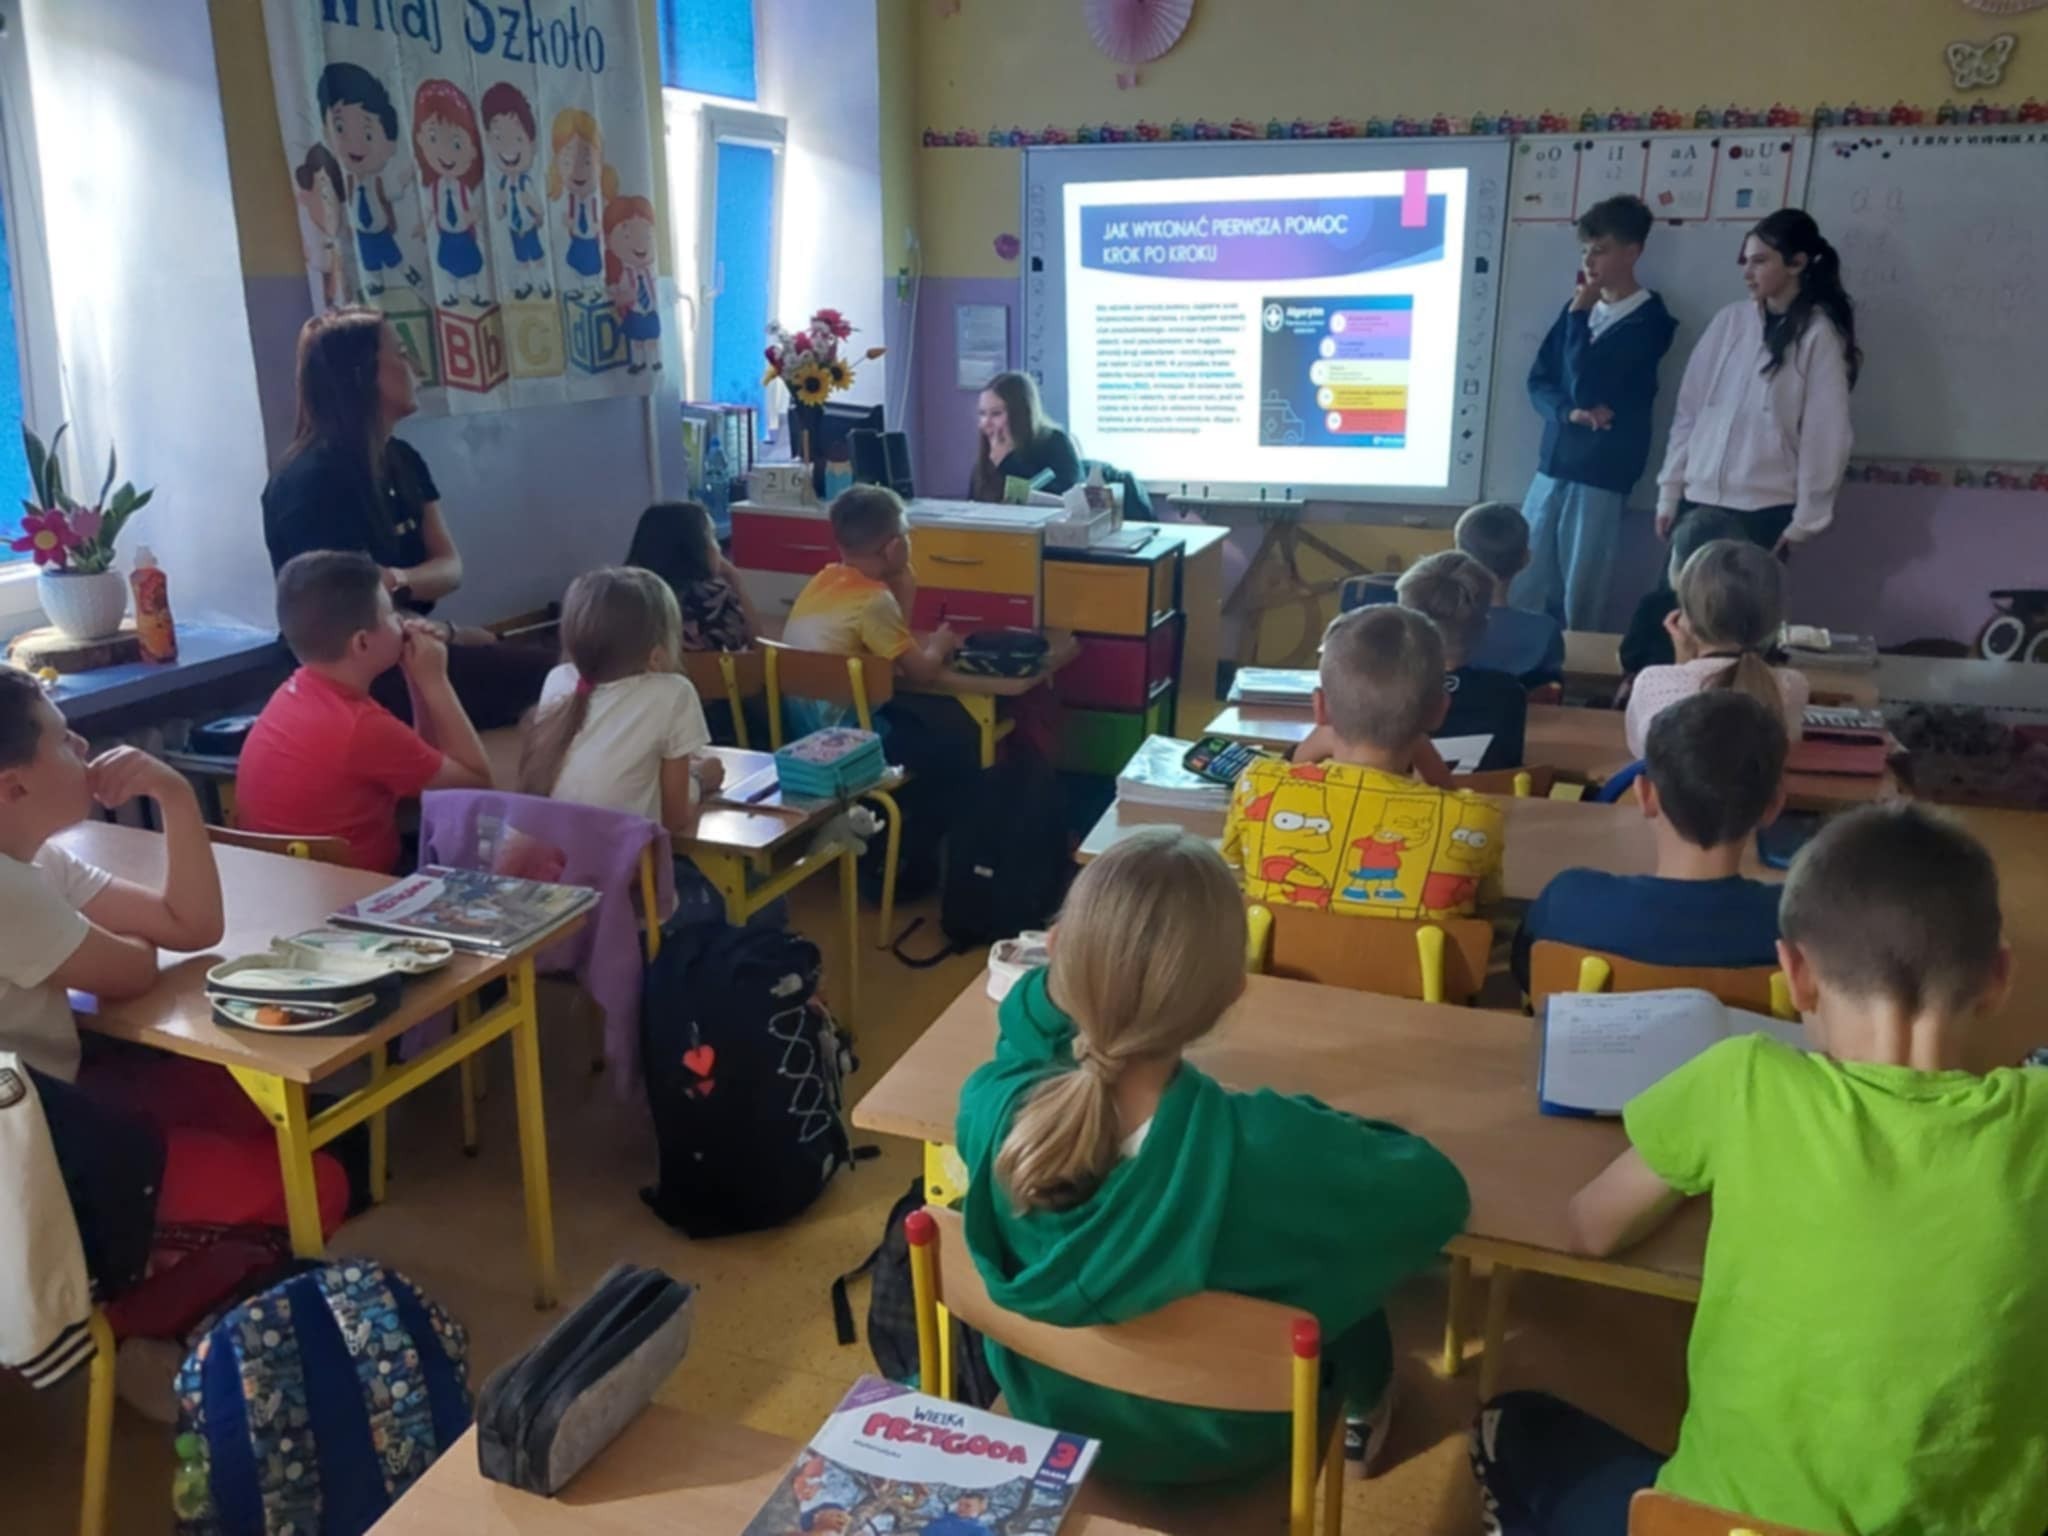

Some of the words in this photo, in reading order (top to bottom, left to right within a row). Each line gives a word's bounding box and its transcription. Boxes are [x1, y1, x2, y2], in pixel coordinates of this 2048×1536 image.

[465, 0, 605, 73] Szkoło
[1103, 222, 1129, 240] JAK
[1132, 213, 1209, 238] WYKONAĆ
[1212, 217, 1281, 236] PIERWSZA
[1284, 214, 1349, 234] POMOC
[1103, 246, 1141, 264] KROK
[1144, 246, 1166, 262] PO
[1169, 244, 1217, 262] KROKU
[862, 1412, 1028, 1465] PRZYGODA
[1048, 1441, 1078, 1468] 3
